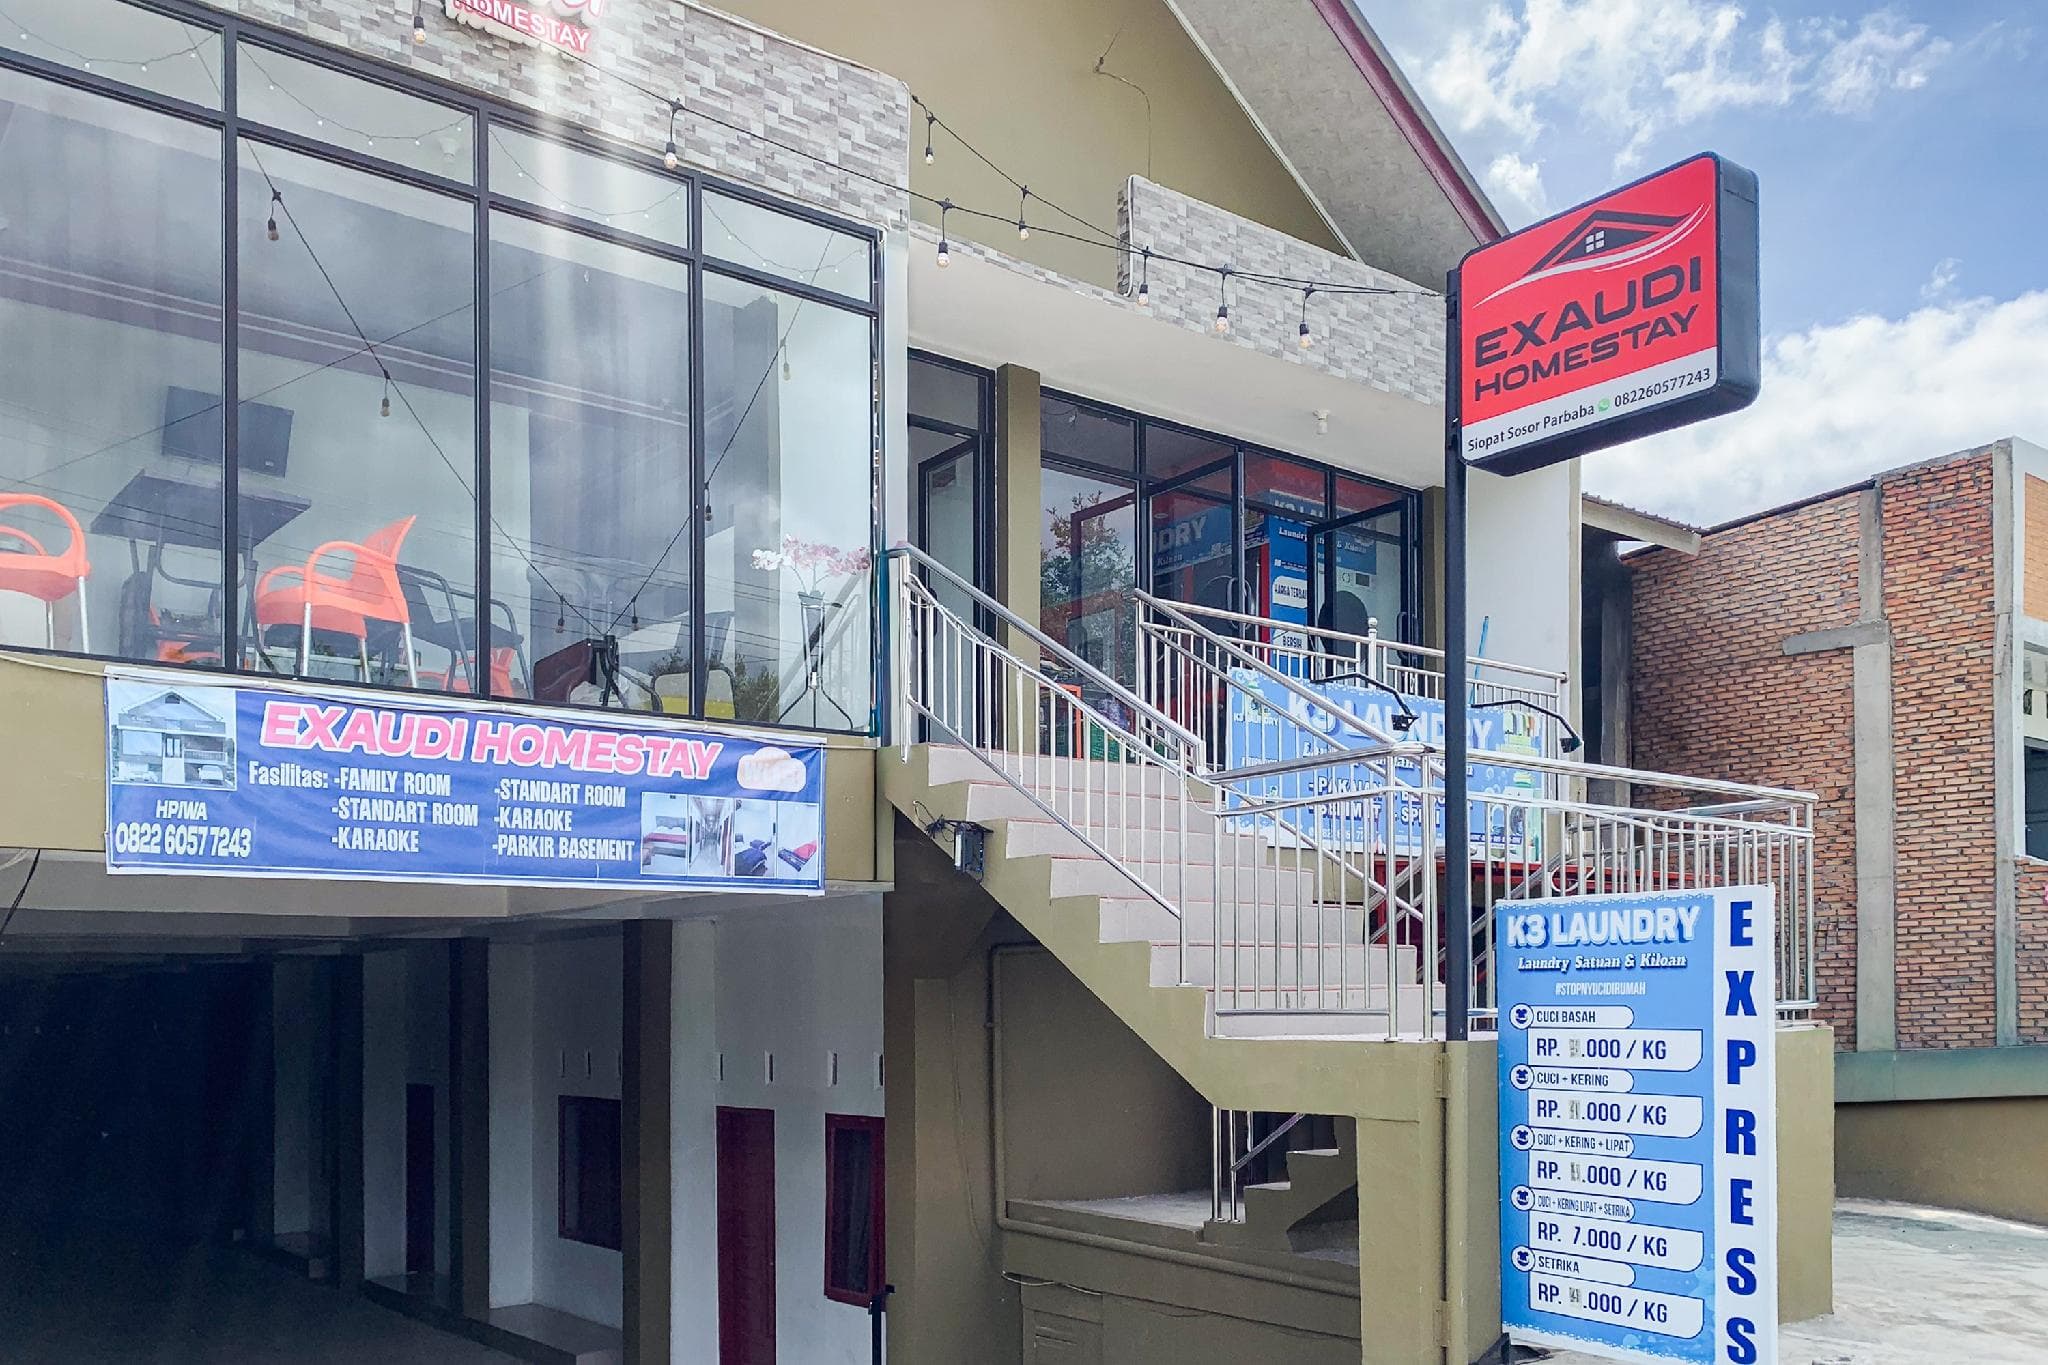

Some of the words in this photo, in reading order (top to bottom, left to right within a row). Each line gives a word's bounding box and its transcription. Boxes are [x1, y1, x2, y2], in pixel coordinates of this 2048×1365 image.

[1475, 256, 1702, 368] EXAUDI
[1474, 304, 1699, 401] HOMESTAY
[1468, 431, 1505, 452] Siopat
[1507, 421, 1540, 439] Sosor
[1543, 402, 1595, 429] Parbaba
[1614, 368, 1710, 407] 082260577243
[260, 700, 468, 761] EXAUDI
[471, 718, 724, 780] HOMESTAY
[249, 761, 329, 788] Fasilitas:
[404, 772, 451, 796] ROOM
[584, 785, 626, 807] ROOM
[432, 803, 479, 827] ROOM
[115, 822, 161, 854] 0822
[558, 837, 636, 861] BASEMENT
[1507, 912, 1548, 948] K3
[1551, 905, 1701, 946] LAUNDRY
[1518, 955, 1569, 974] Laundry
[1575, 954, 1622, 970] Satuan
[1625, 953, 1636, 969] &
[1639, 952, 1688, 968] Kiloan
[1555, 981, 1647, 996] #STOPNYUCIDIRUMAH
[1536, 1010, 1559, 1023] CUCI
[1561, 1011, 1596, 1023] BASAH
[1536, 1038, 1560, 1057] RP.
[1642, 1040, 1667, 1060] KG
[1537, 1072, 1559, 1085] CUCI
[1570, 1073, 1609, 1087] KERING
[1537, 1099, 1561, 1119] RP.
[1643, 1105, 1667, 1126] KG
[1537, 1133, 1556, 1146] CUCI
[1565, 1136, 1596, 1149] KERING
[1605, 1139, 1630, 1152] LIPAT
[1725, 901, 1758, 1365] EXPRESS
[1537, 1160, 1561, 1180] RP.
[1643, 1170, 1667, 1191] KG
[1580, 1201, 1597, 1213] LIPAT
[1603, 1203, 1630, 1217] SETRIKA
[1538, 1221, 1561, 1242] RP.
[1573, 1226, 1621, 1251] 7.000
[1644, 1235, 1667, 1257] KG
[1538, 1255, 1579, 1273] SETRIKA
[1538, 1282, 1562, 1305] RP.
[1644, 1301, 1668, 1323] KG
